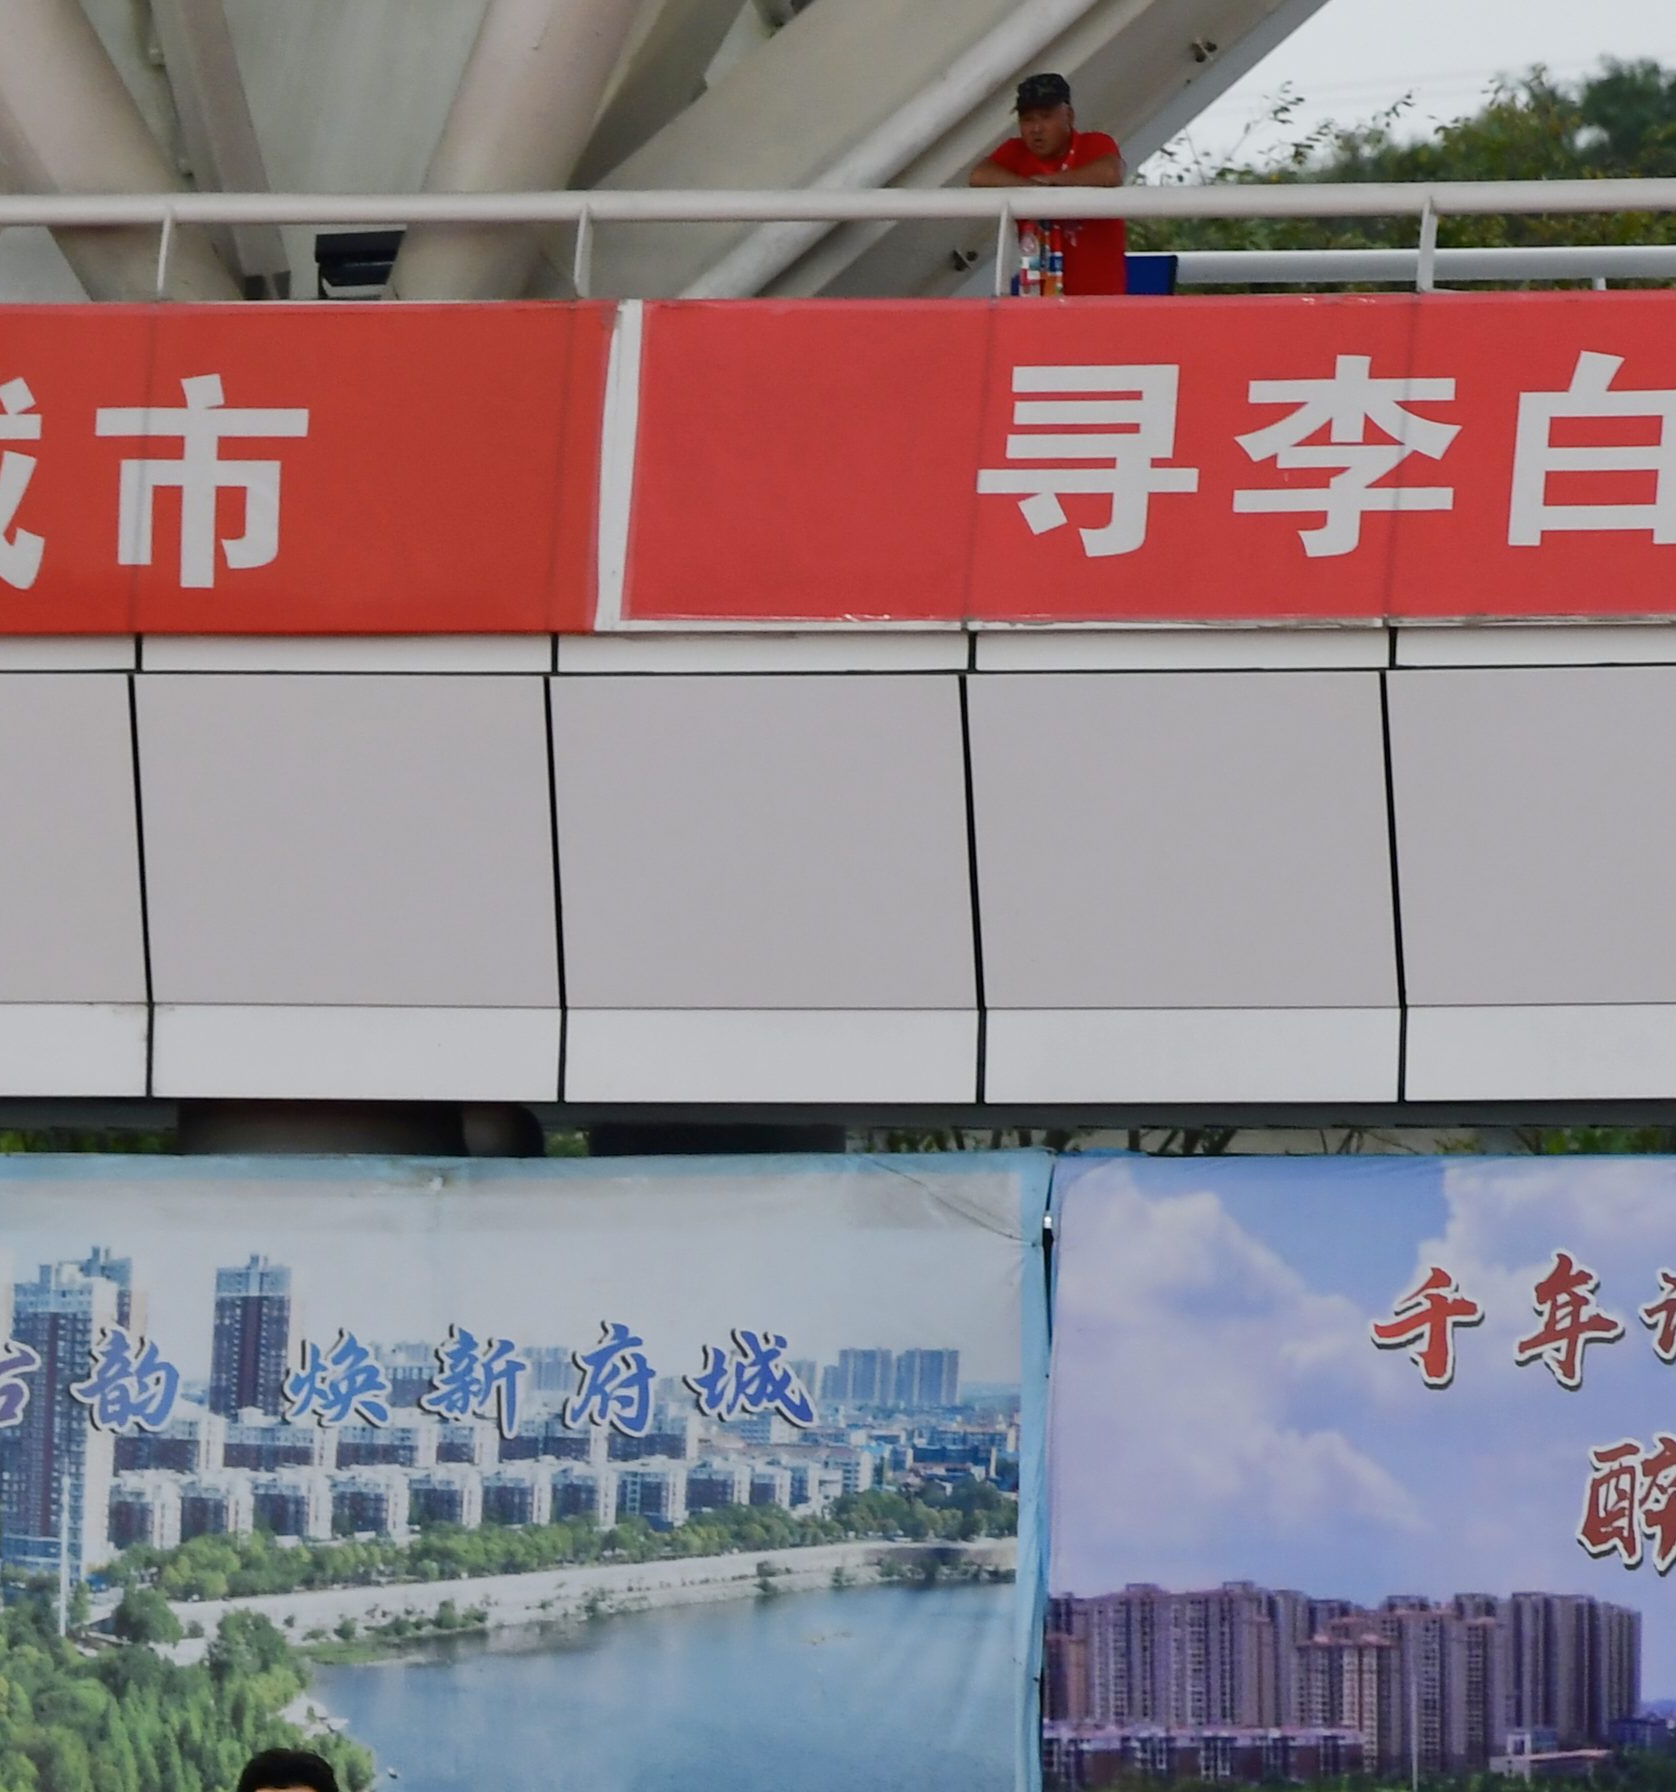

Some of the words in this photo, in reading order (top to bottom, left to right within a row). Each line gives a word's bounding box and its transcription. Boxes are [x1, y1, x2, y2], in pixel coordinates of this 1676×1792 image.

[977, 350, 1676, 558] 寻李白
[284, 1322, 819, 1438] 焕新府城
